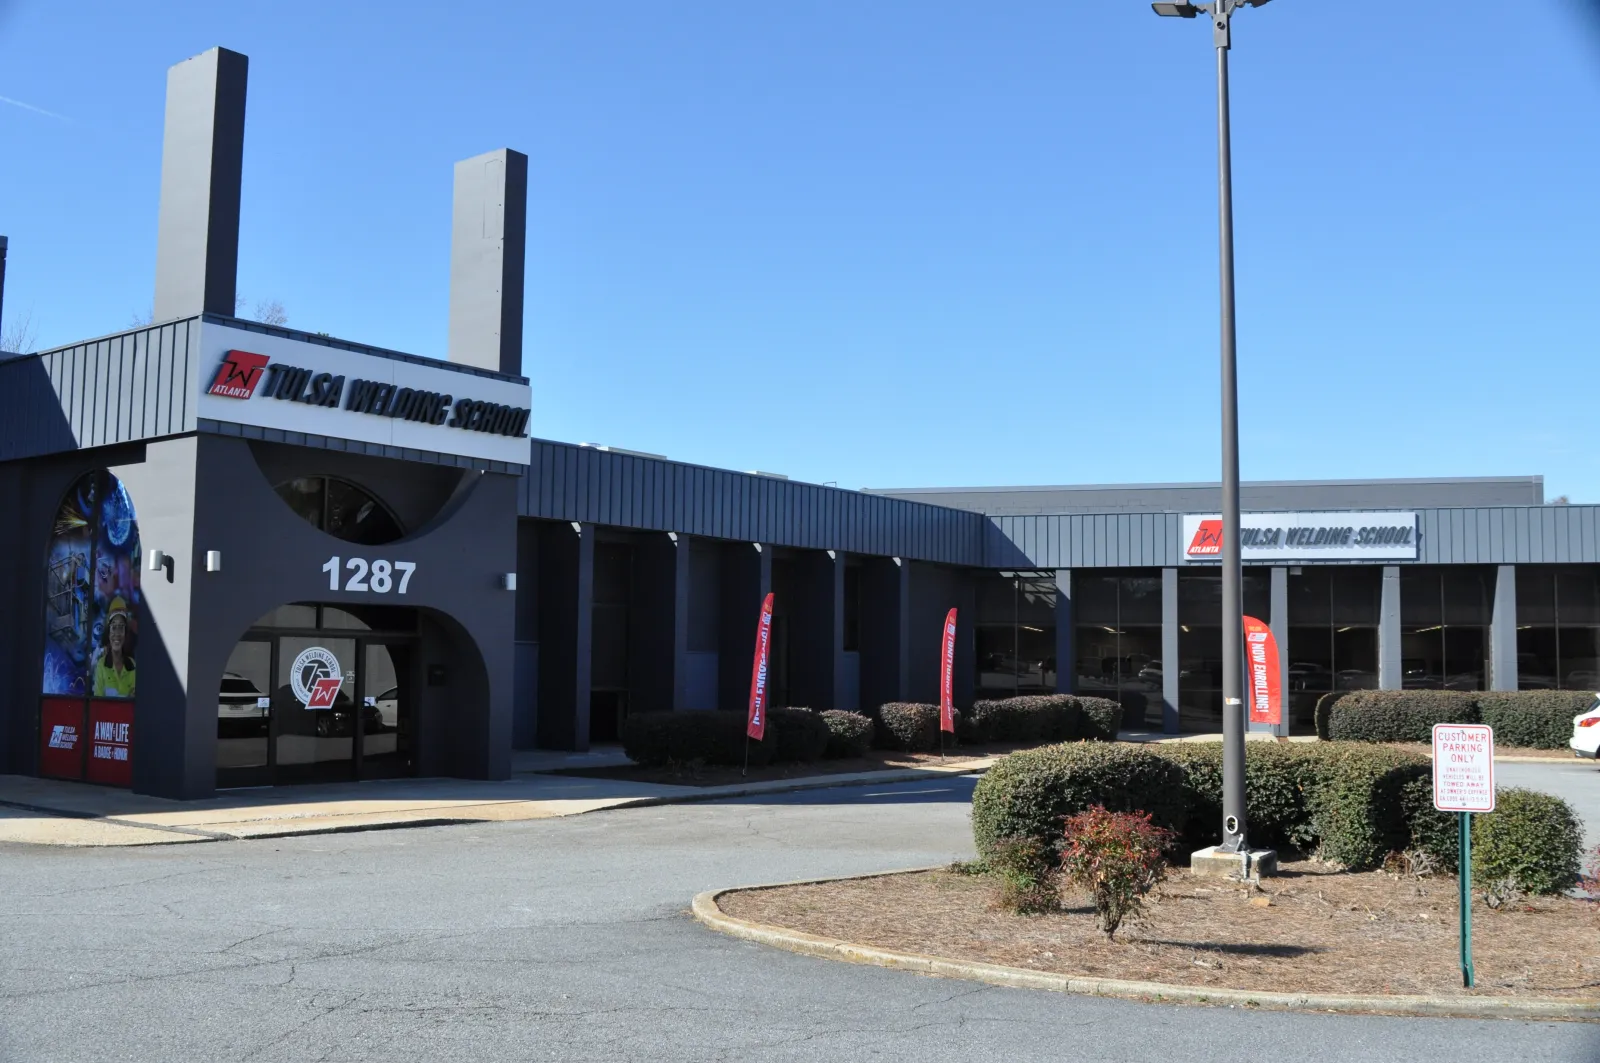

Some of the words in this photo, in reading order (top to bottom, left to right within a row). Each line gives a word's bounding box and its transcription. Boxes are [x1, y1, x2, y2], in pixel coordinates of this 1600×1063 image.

[213, 384, 250, 398] ATLANTA
[263, 363, 345, 408] TULSA
[346, 378, 453, 426] WELDING
[449, 397, 531, 438] SCHOOL
[1285, 526, 1353, 546] WELDING
[1354, 525, 1413, 546] SCHOOL
[322, 555, 417, 594] 1287
[295, 658, 306, 674] TULSA
[305, 651, 325, 660] WELDING
[325, 655, 337, 673] SCHOOL
[1252, 643, 1265, 663] NOW
[1254, 664, 1269, 712] ENROLLING!
[94, 721, 99, 740] A
[100, 722, 114, 740] WAY
[116, 723, 129, 742] LIFE
[1438, 732, 1487, 742] CUSTOMER
[1442, 743, 1483, 752] PARKING
[1450, 754, 1475, 763] ONLY
